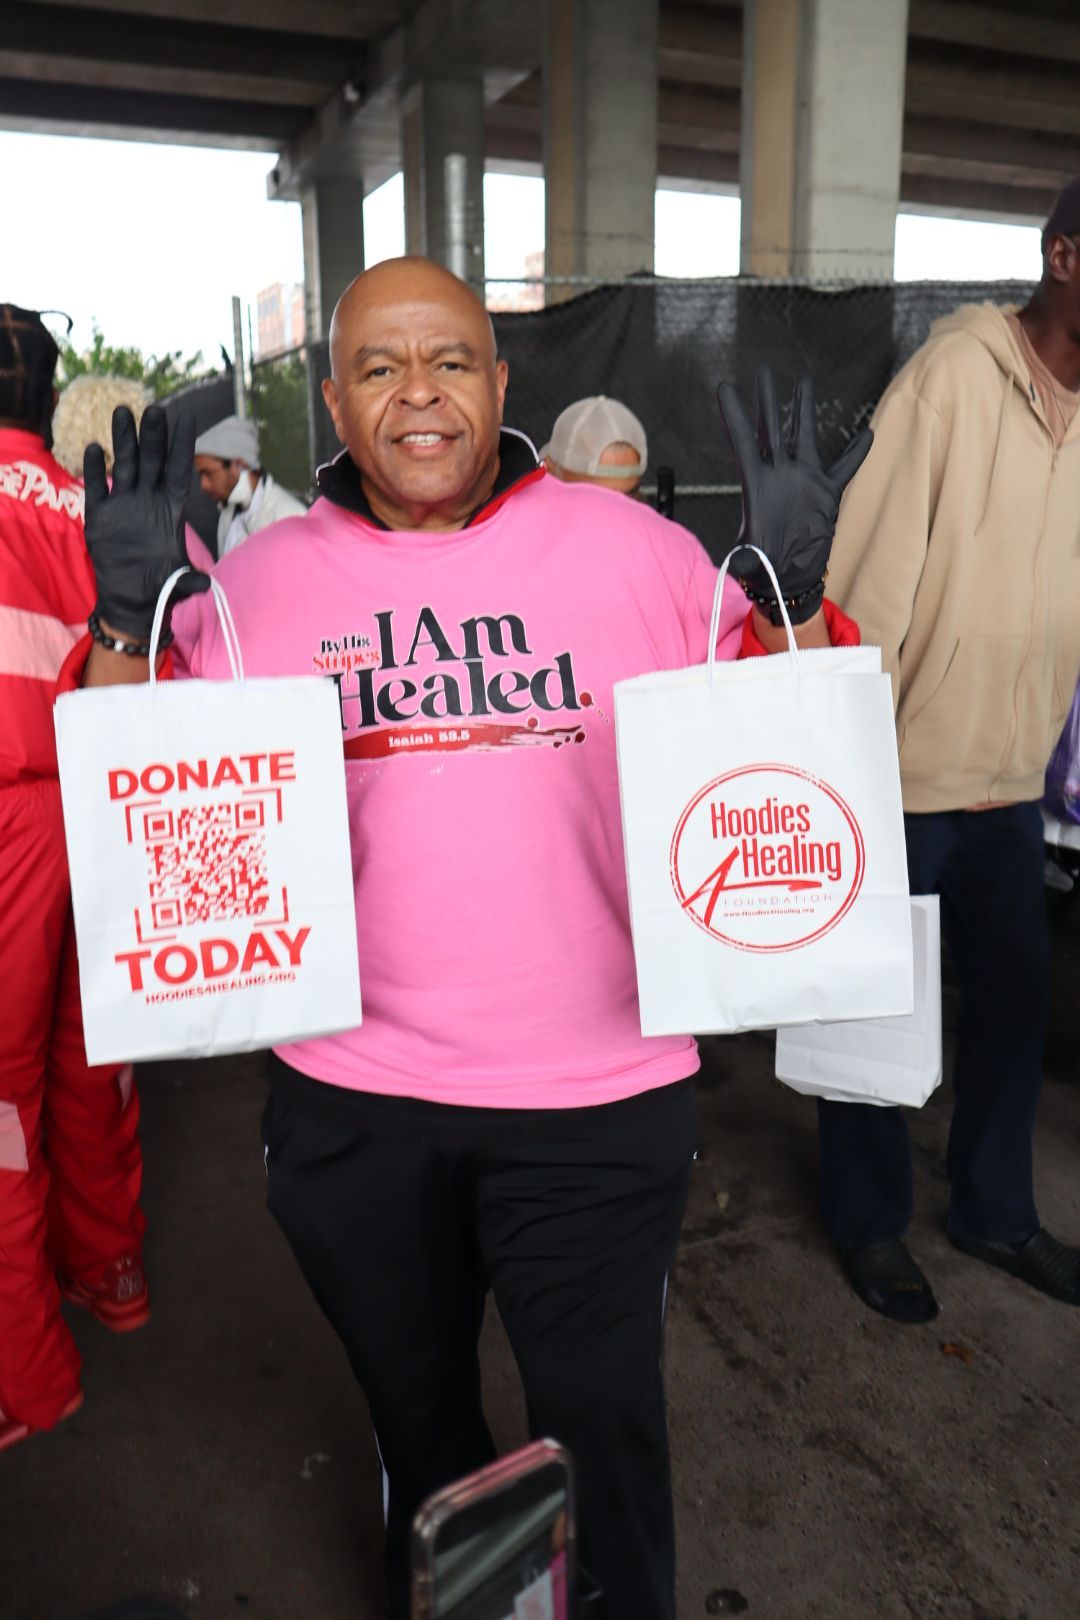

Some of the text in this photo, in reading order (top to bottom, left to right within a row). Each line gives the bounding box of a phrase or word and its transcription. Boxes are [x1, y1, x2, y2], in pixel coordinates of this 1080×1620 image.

[321, 635, 370, 654] By His
[374, 607, 532, 670] I Am
[388, 733, 434, 748] Isaiah
[107, 751, 297, 801] DONATE
[710, 797, 811, 840] Hoodies
[741, 833, 842, 882] Healing
[723, 893, 833, 908] FOUNDATION
[723, 907, 815, 918] www.Hoodies4Healing.org
[114, 926, 312, 994] TODAY
[145, 972, 298, 1006] HOODIES4HEALING.ORG
